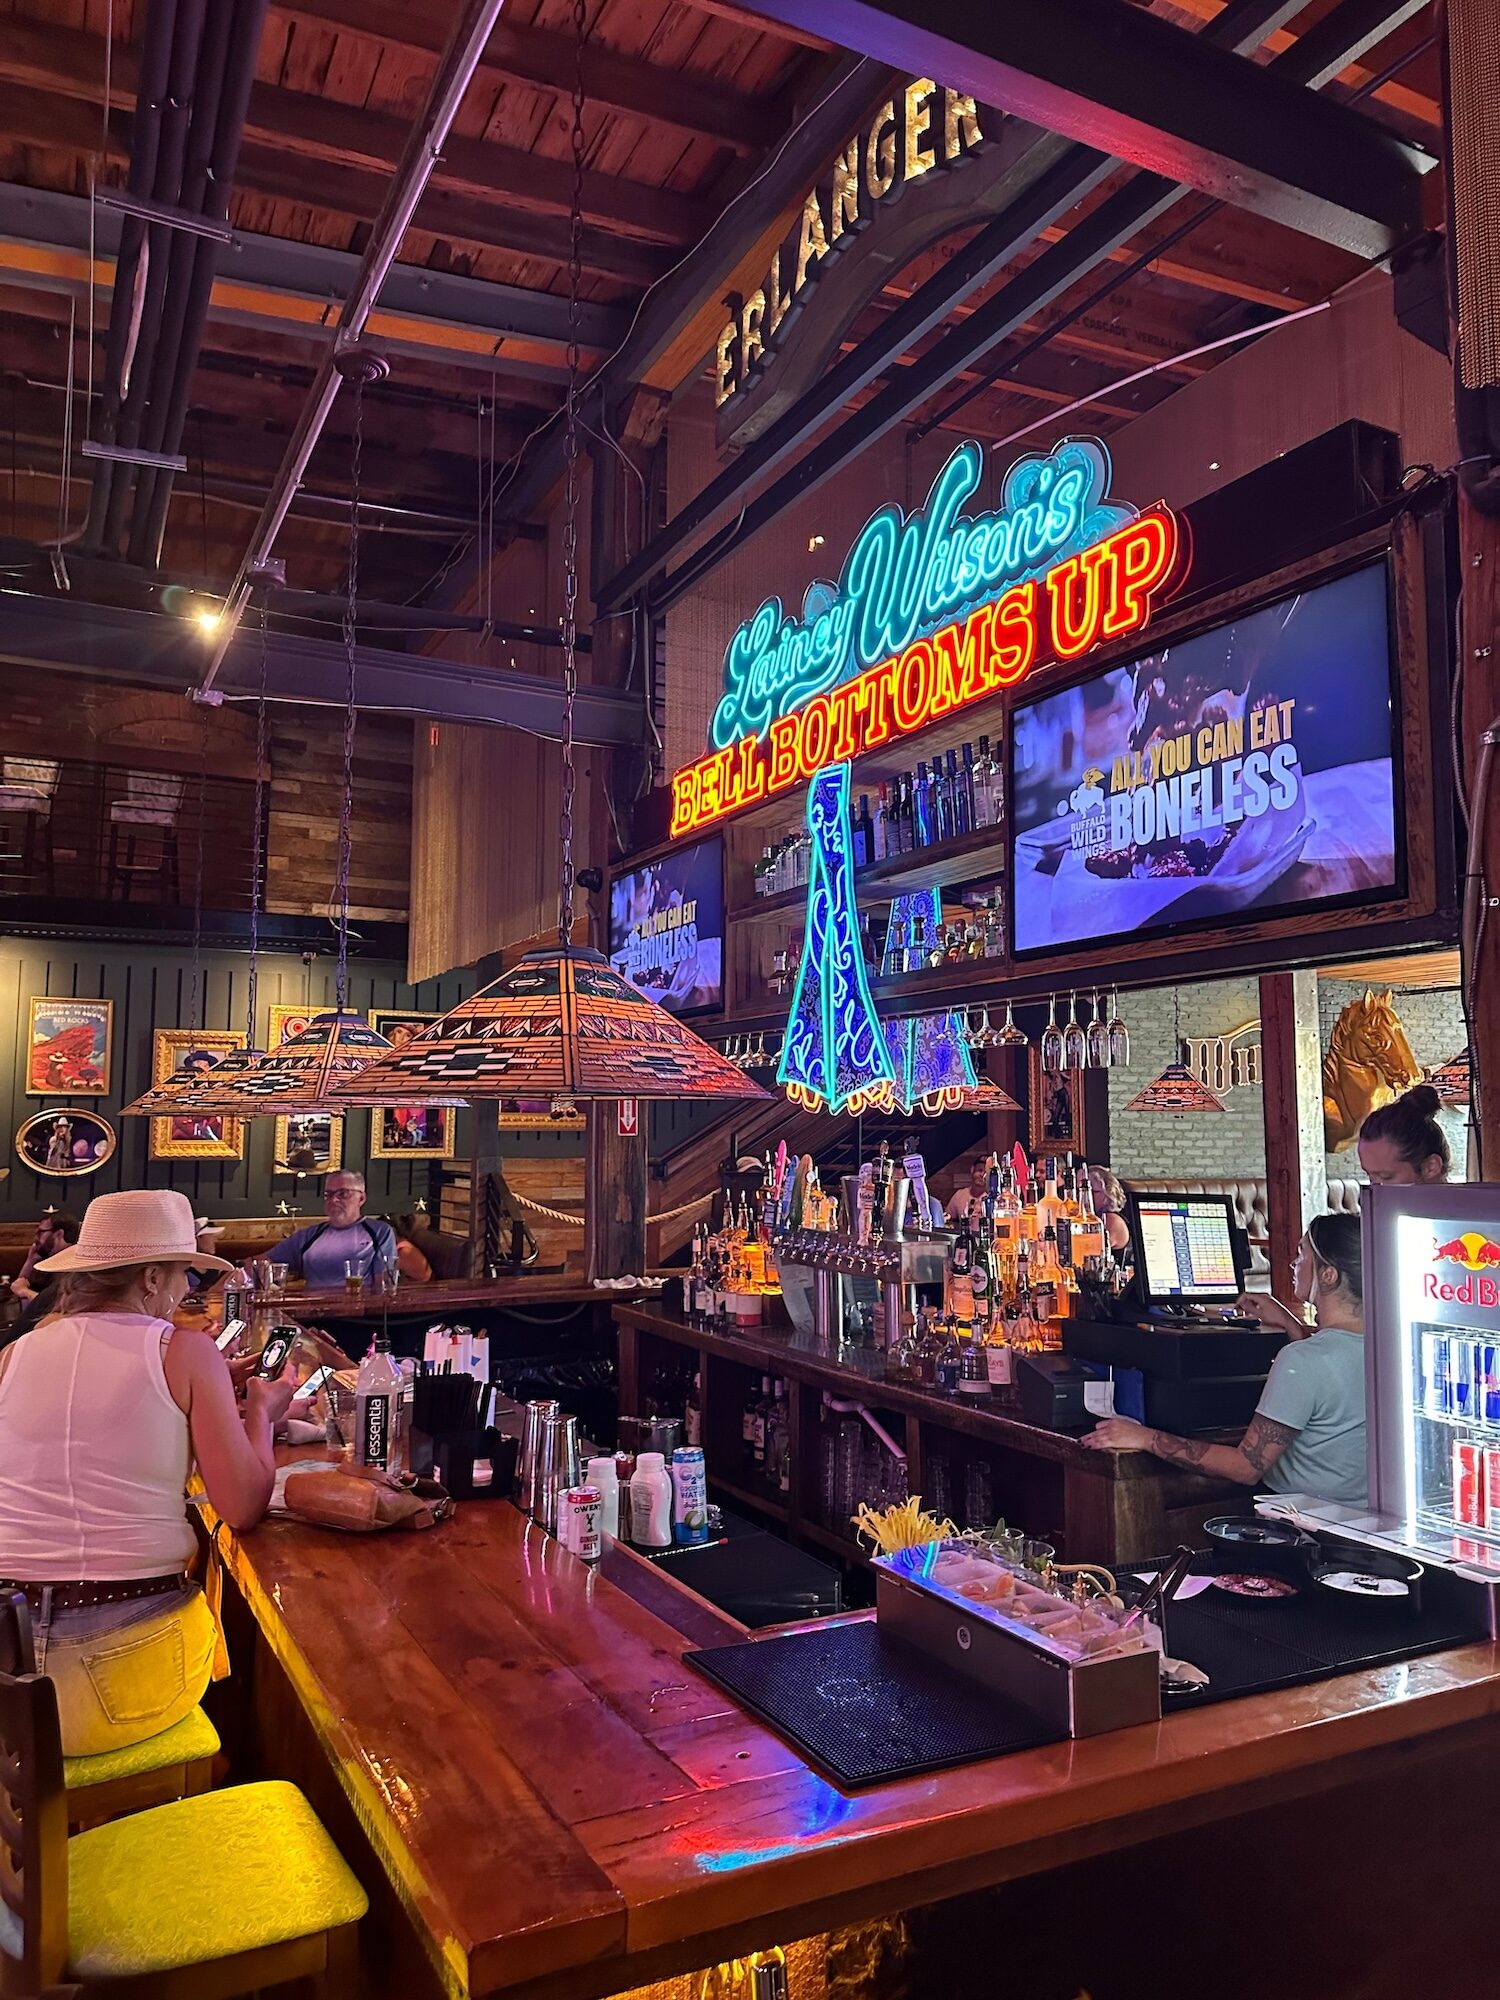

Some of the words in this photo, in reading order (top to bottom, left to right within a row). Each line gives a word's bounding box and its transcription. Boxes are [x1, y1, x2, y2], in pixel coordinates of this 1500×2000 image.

[716, 77, 984, 408] ERLANGER
[713, 599, 856, 749] Lainey
[848, 453, 1084, 663] Wilson's
[671, 735, 765, 839] BELL
[770, 583, 1035, 785] BOTTOMS
[1048, 512, 1174, 657] UP
[1110, 750, 1145, 793] ALL
[1150, 734, 1191, 779] YOU
[1197, 719, 1243, 766] CAN
[1250, 699, 1296, 749] EAT
[1111, 743, 1299, 851] BONELESS
[1070, 815, 1106, 832] BUFFALO
[1071, 826, 1106, 848] WILD
[1072, 844, 1106, 861] WINGS
[683, 900, 697, 924] EAT
[640, 923, 698, 973] BONELESS
[1424, 1273, 1474, 1306] Red
[369, 1398, 382, 1457] essentia
[1467, 1493, 1478, 1510] Bull
